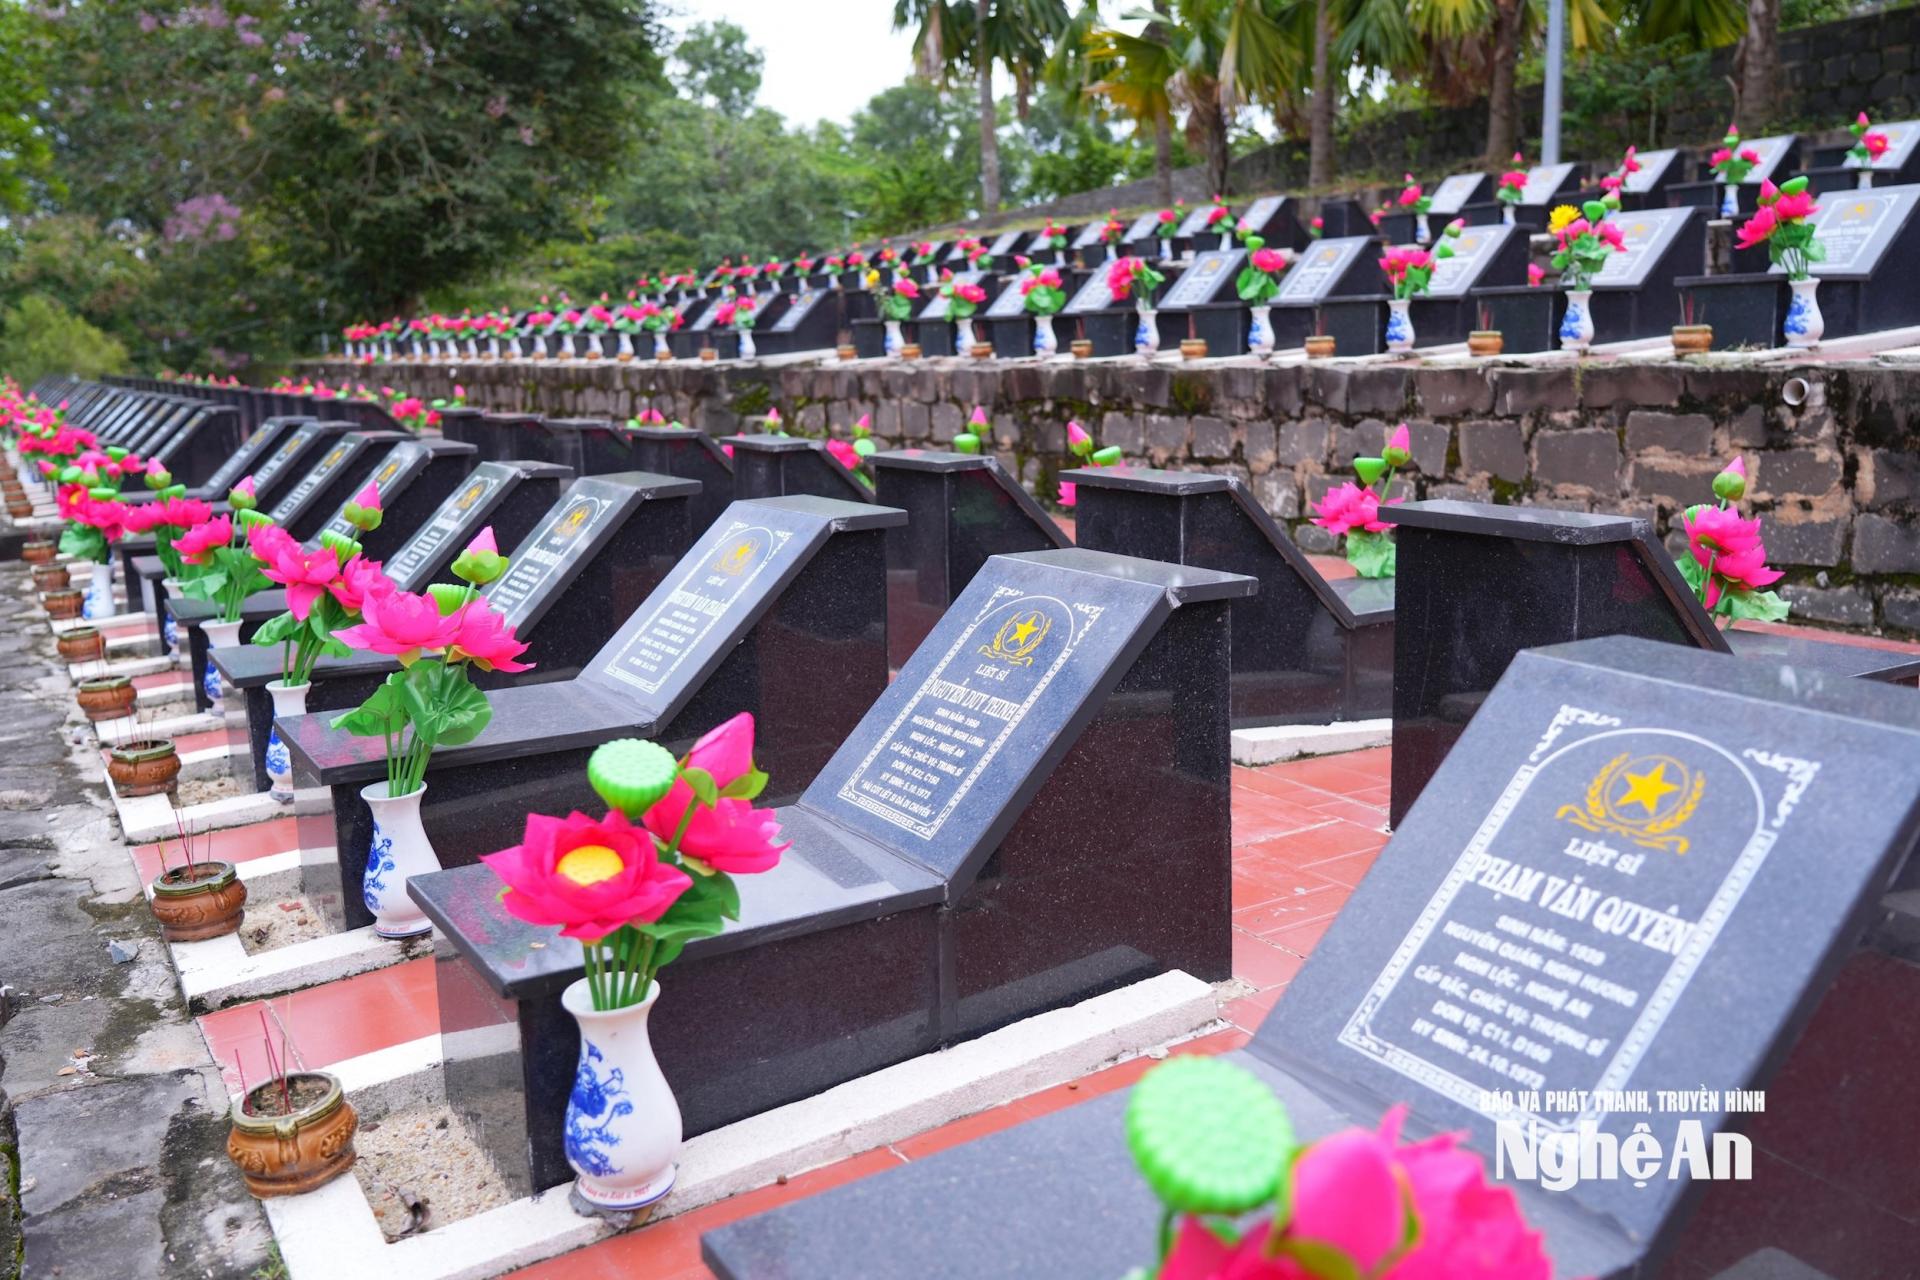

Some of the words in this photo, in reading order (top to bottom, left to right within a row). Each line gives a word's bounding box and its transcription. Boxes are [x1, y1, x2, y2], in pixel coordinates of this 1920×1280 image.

[961, 689, 990, 710] DUY
[1564, 838, 1617, 865] LIỆT
[1464, 852, 1545, 901] PHẠM
[1539, 875, 1600, 920] VĂN
